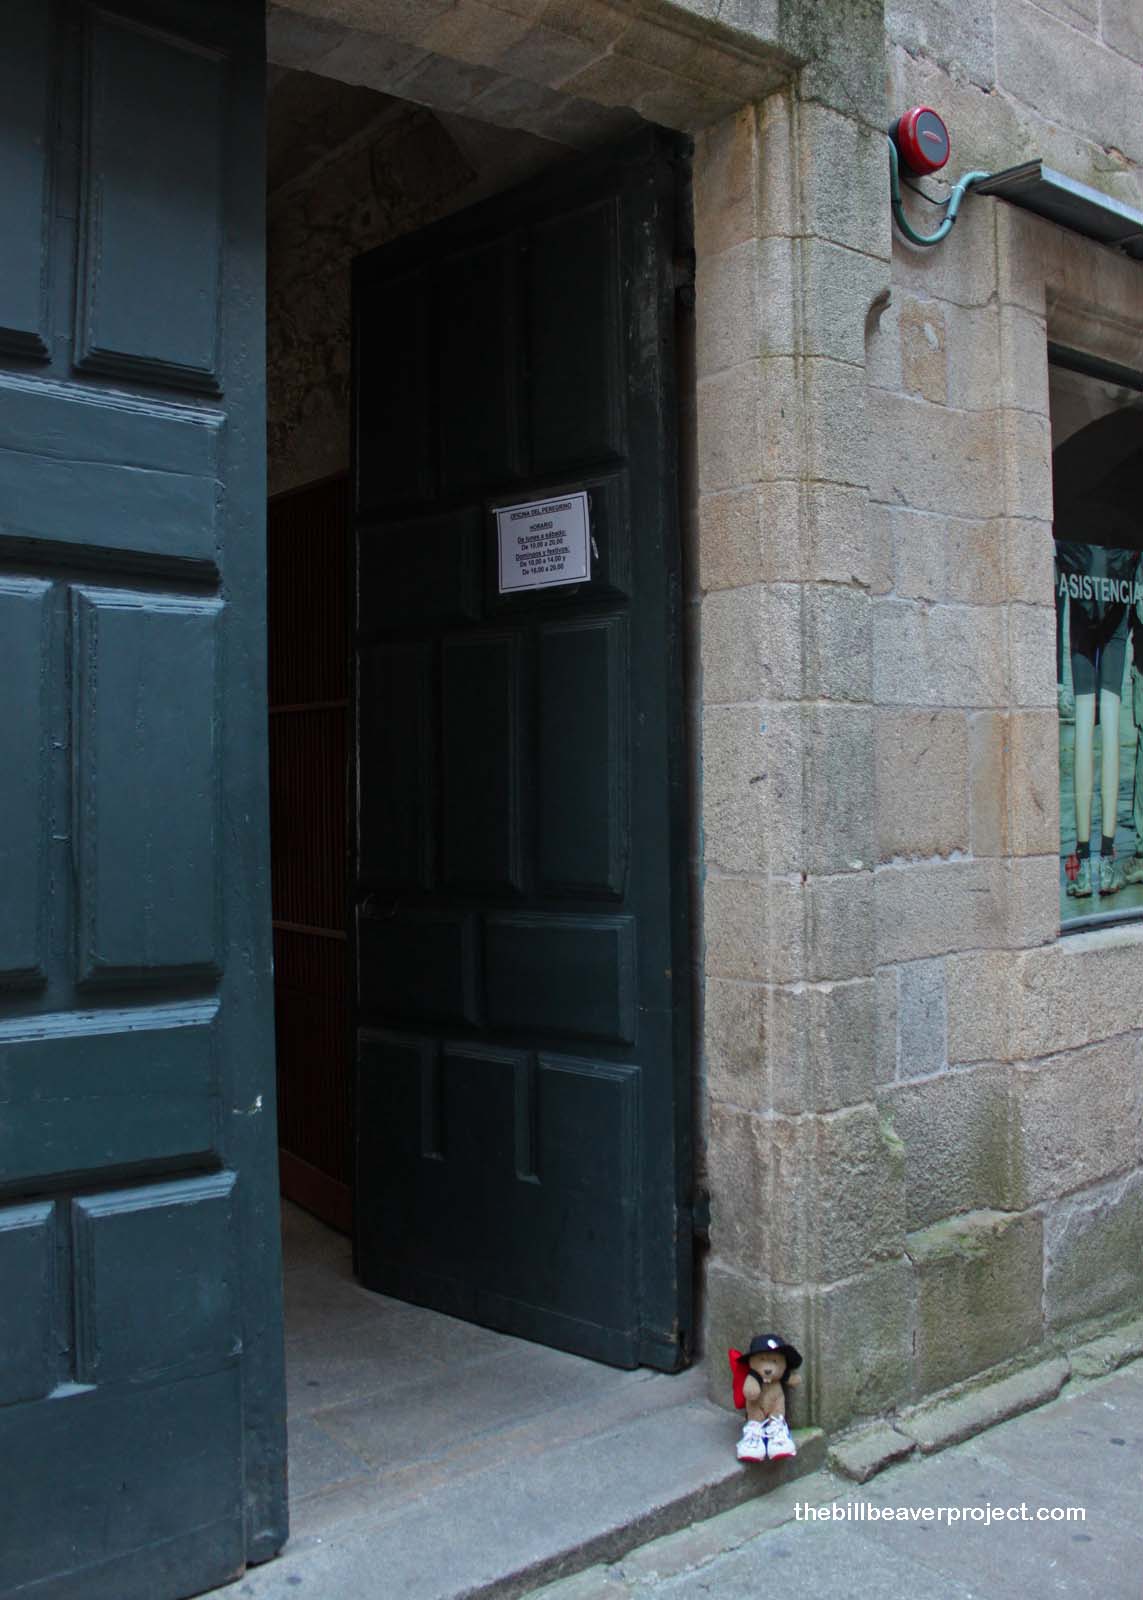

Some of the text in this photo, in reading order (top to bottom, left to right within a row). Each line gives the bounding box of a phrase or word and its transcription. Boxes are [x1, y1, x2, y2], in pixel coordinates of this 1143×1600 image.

[531, 508, 540, 516] DEL
[541, 503, 572, 514] PEREGRINO
[529, 521, 553, 532] HORARIO
[519, 560, 527, 568] De
[522, 568, 530, 576] De
